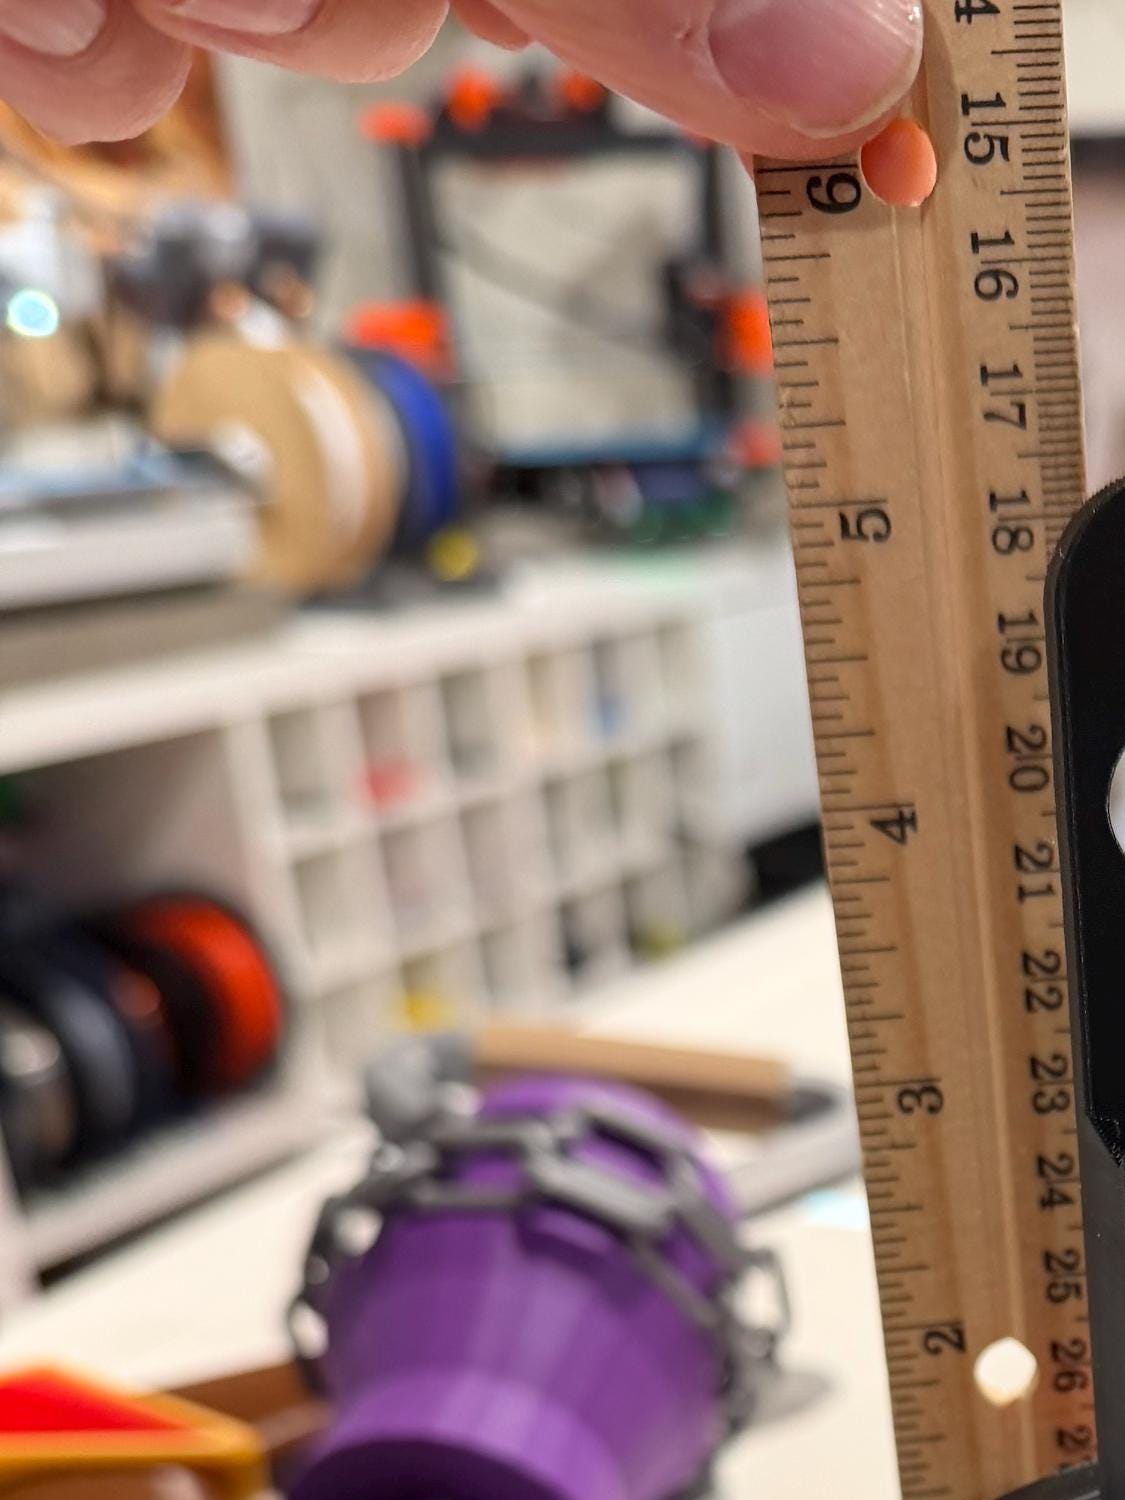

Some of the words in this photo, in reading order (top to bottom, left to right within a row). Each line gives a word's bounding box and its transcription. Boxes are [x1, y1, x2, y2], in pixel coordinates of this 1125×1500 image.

[961, 92, 1010, 165] 15
[970, 231, 1019, 302] 16
[980, 363, 1028, 431] 17
[839, 507, 892, 544] 5
[988, 489, 1034, 556] 18
[997, 611, 1042, 675] 19
[1005, 724, 1049, 794] 20
[870, 808, 918, 845] 4
[1013, 842, 1055, 904] 21
[1021, 950, 1063, 1014] 22
[897, 1083, 944, 1115] 3
[1029, 1053, 1070, 1115] 23
[1037, 1153, 1076, 1211] 24
[1042, 1248, 1082, 1305] 25
[923, 1321, 966, 1355] 2
[1050, 1337, 1088, 1393] 26
